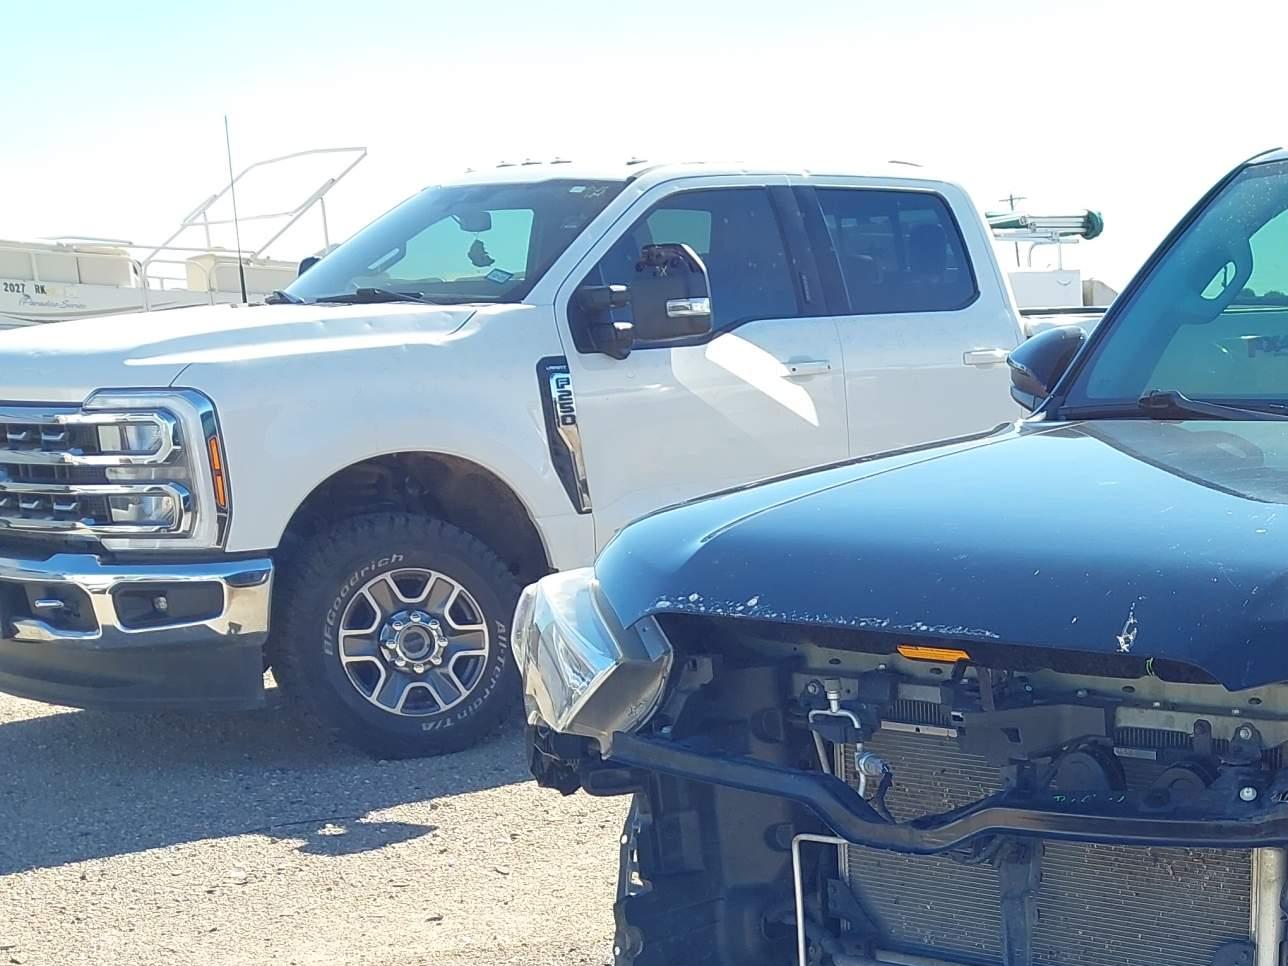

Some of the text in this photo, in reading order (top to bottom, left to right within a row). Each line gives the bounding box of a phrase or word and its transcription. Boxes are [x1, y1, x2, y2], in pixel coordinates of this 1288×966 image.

[3, 282, 26, 294] 2027
[555, 377, 577, 426] F250
[323, 553, 404, 656] BFGoodrich
